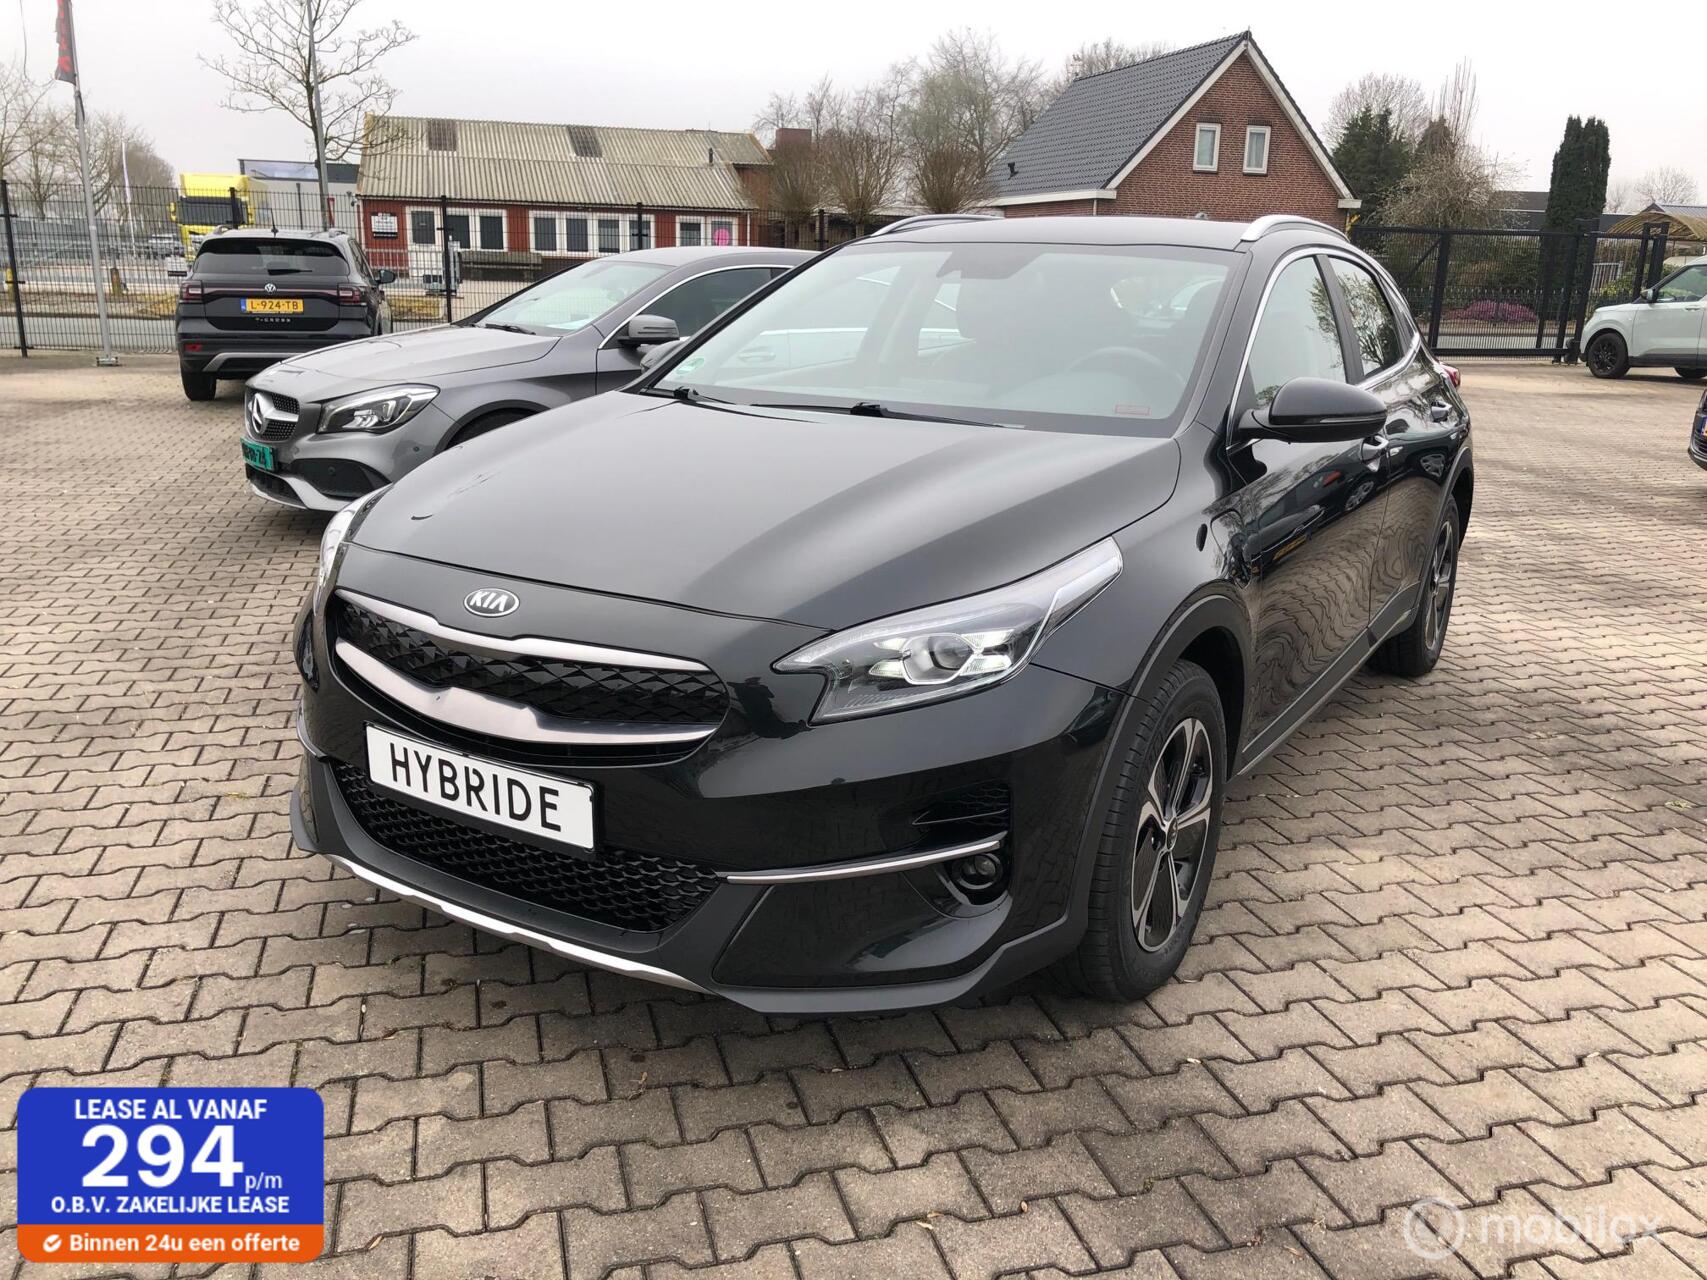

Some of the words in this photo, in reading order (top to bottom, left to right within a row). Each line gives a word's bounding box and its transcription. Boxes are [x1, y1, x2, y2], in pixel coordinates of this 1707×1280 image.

[250, 300, 299, 311] L-924-TB
[469, 589, 508, 613] KIA
[389, 742, 562, 833] HYBRIDE
